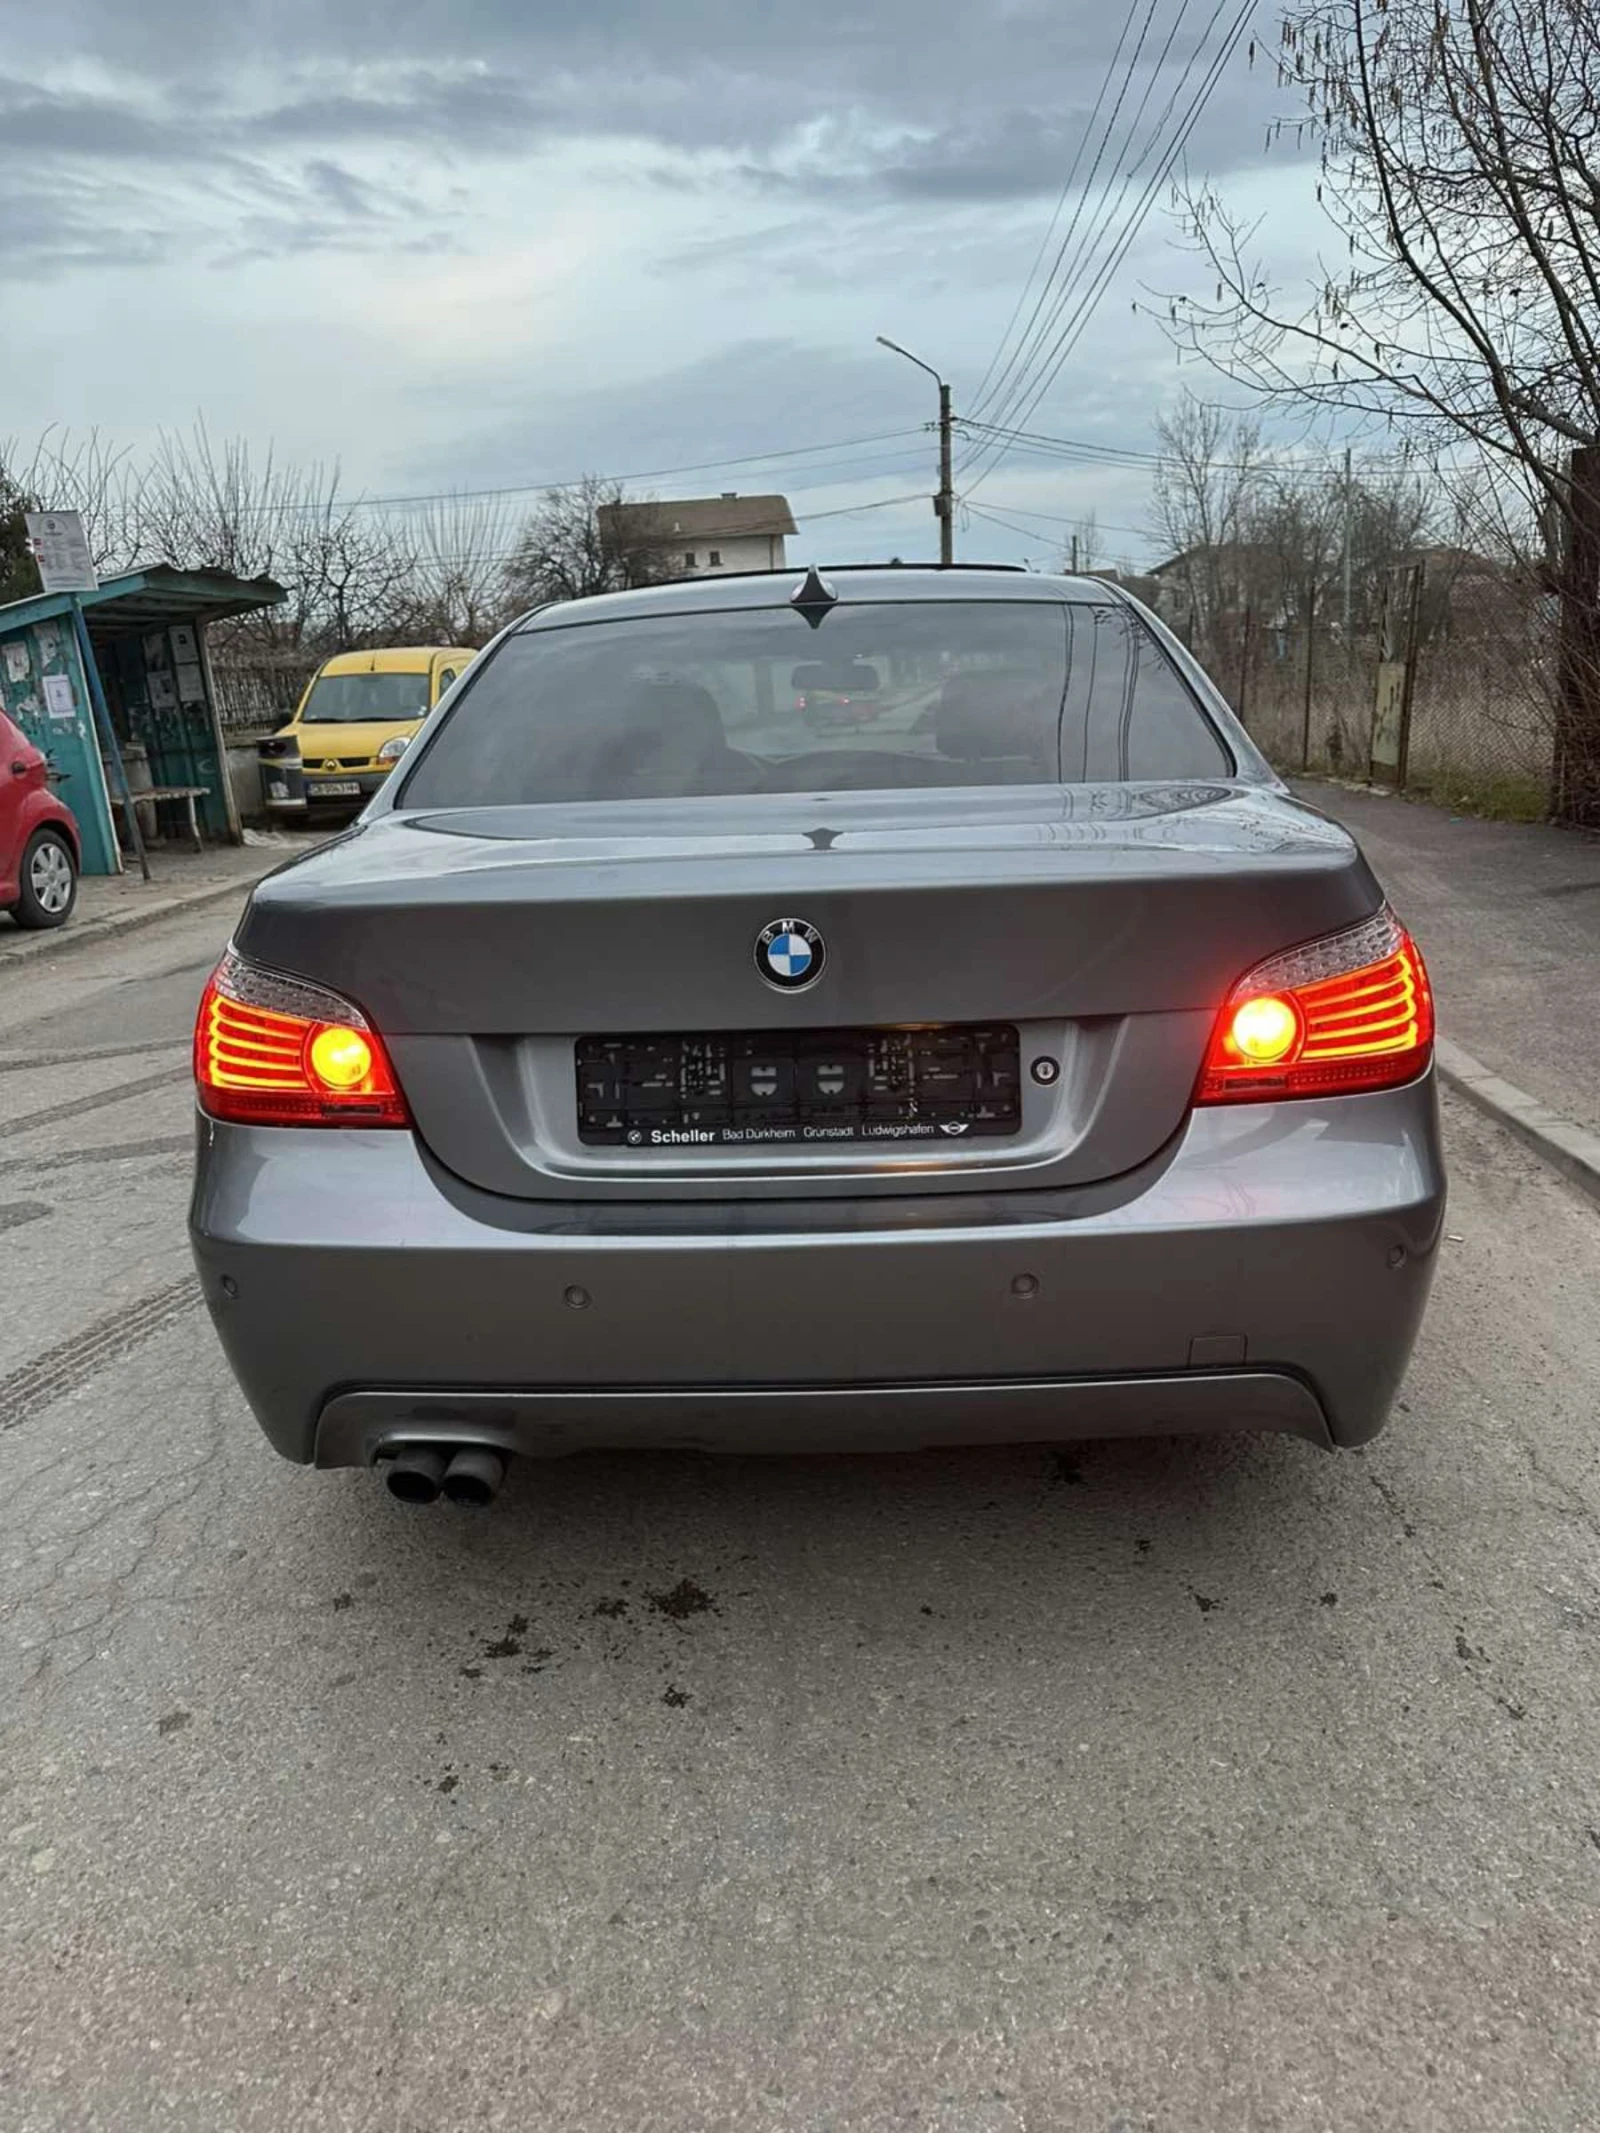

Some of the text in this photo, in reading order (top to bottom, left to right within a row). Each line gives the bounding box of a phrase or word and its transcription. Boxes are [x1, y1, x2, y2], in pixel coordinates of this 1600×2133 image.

[760, 920, 820, 945] BMW
[651, 1129, 715, 1143] Scheller
[722, 1128, 743, 1140] Bad
[861, 1123, 934, 1137] Ludwigshafen
